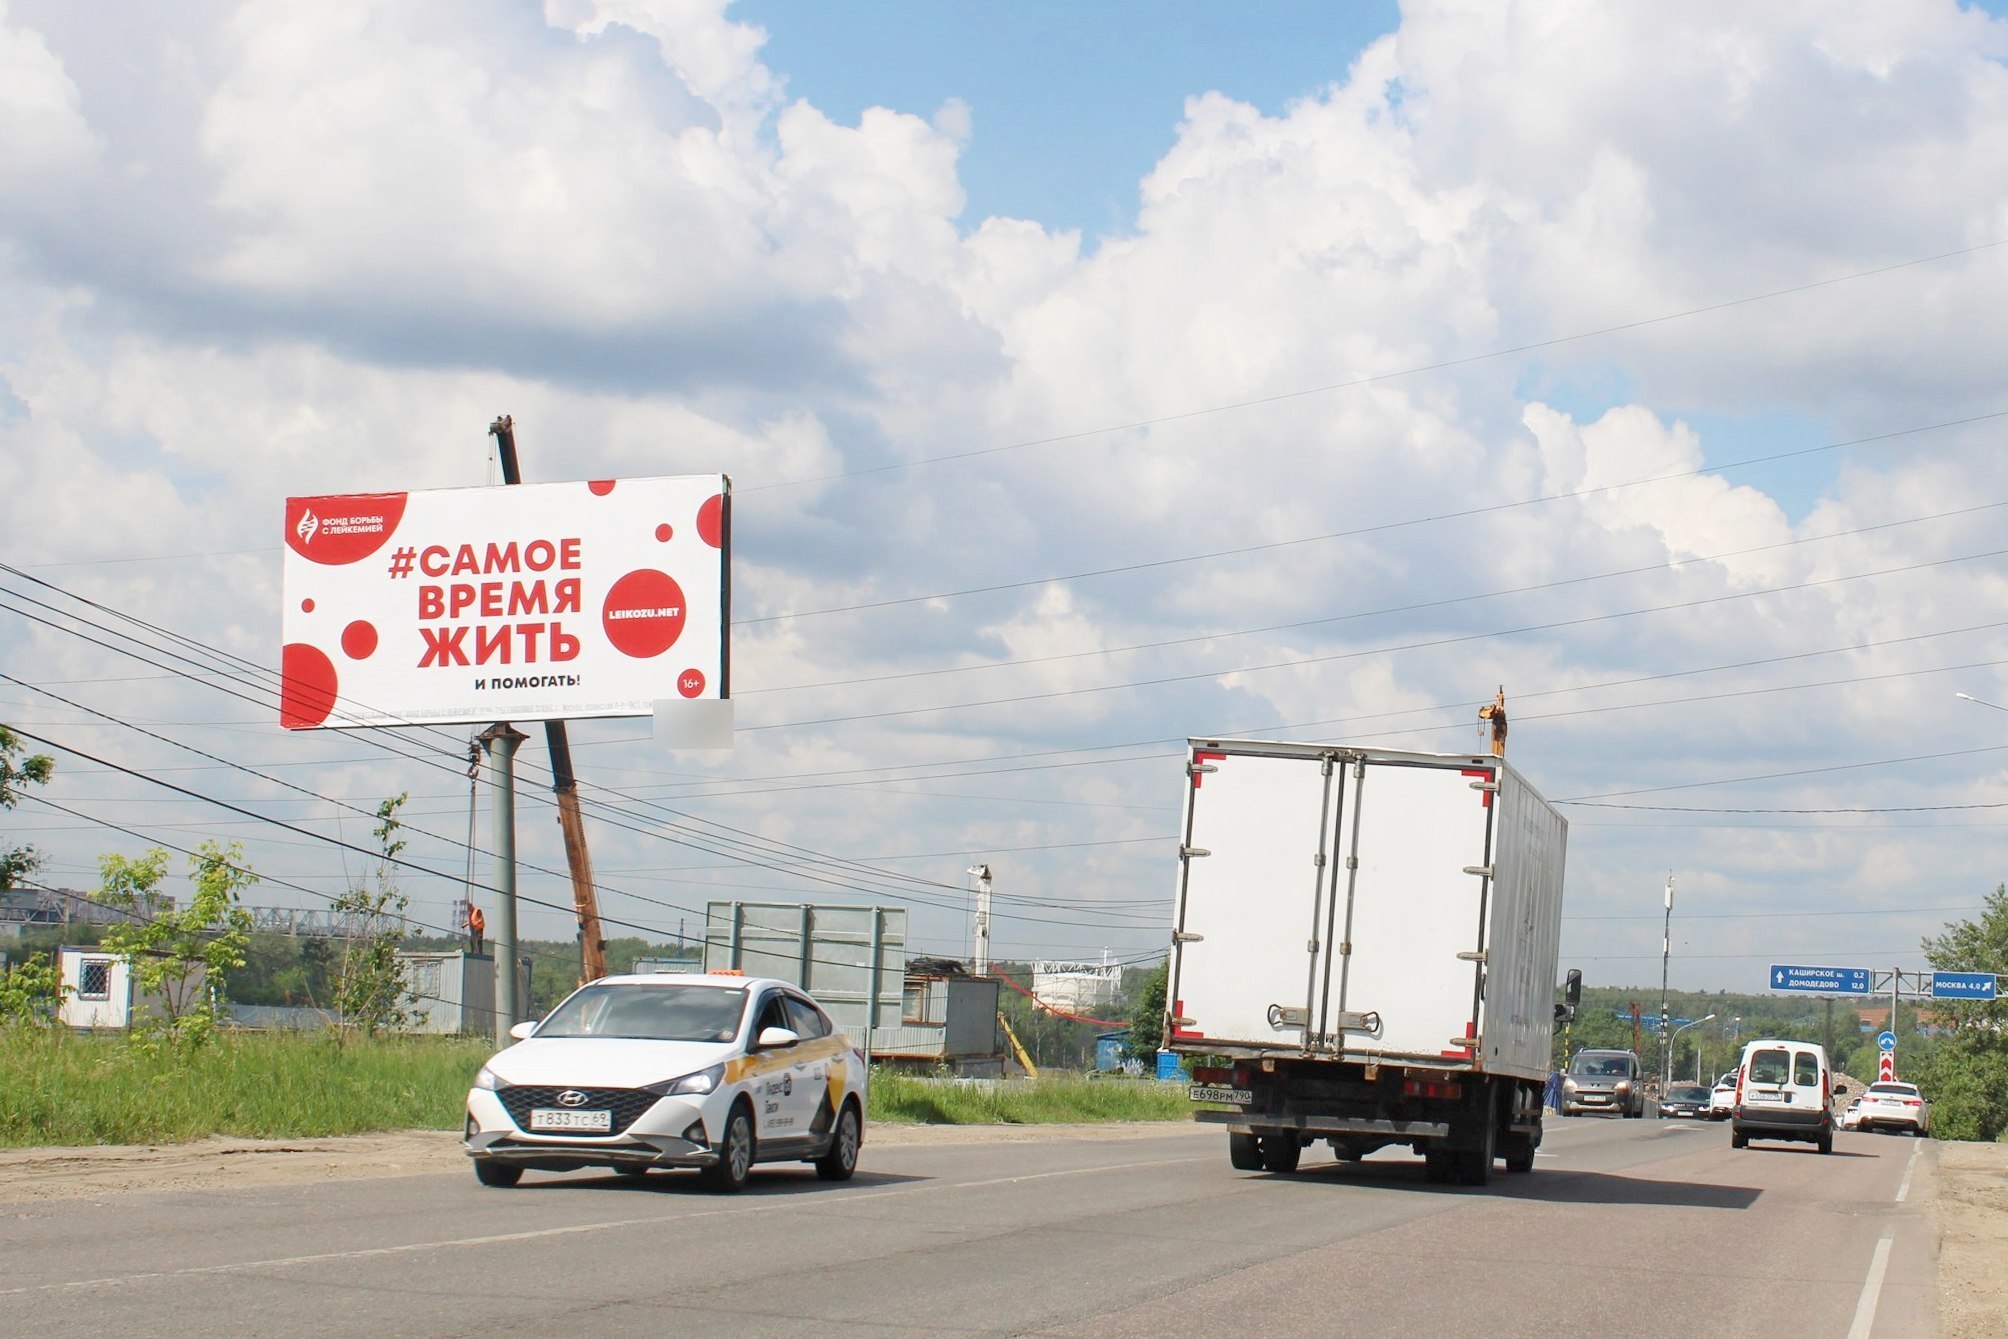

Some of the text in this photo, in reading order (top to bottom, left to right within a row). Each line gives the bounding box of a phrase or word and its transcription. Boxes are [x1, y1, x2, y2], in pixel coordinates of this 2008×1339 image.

[322, 515, 383, 526] ФОНД БОРЬБЫ
[322, 523, 383, 535] С ЛЕЙКЕМИЕЙ
[388, 538, 581, 579] #САМОЕ
[418, 578, 581, 620] ВРЕМЯ
[609, 607, 679, 620] LEIKOZU.NET
[417, 622, 581, 668] ЖИТЬ
[475, 675, 581, 690] И ПОМОГАТЬ!
[683, 679, 699, 688] 16+
[1788, 968, 1835, 978] КАШИРСКОЕ
[1788, 979, 1840, 989] ДОМОДЕДОВО
[1935, 981, 1967, 989] МОСКВА
